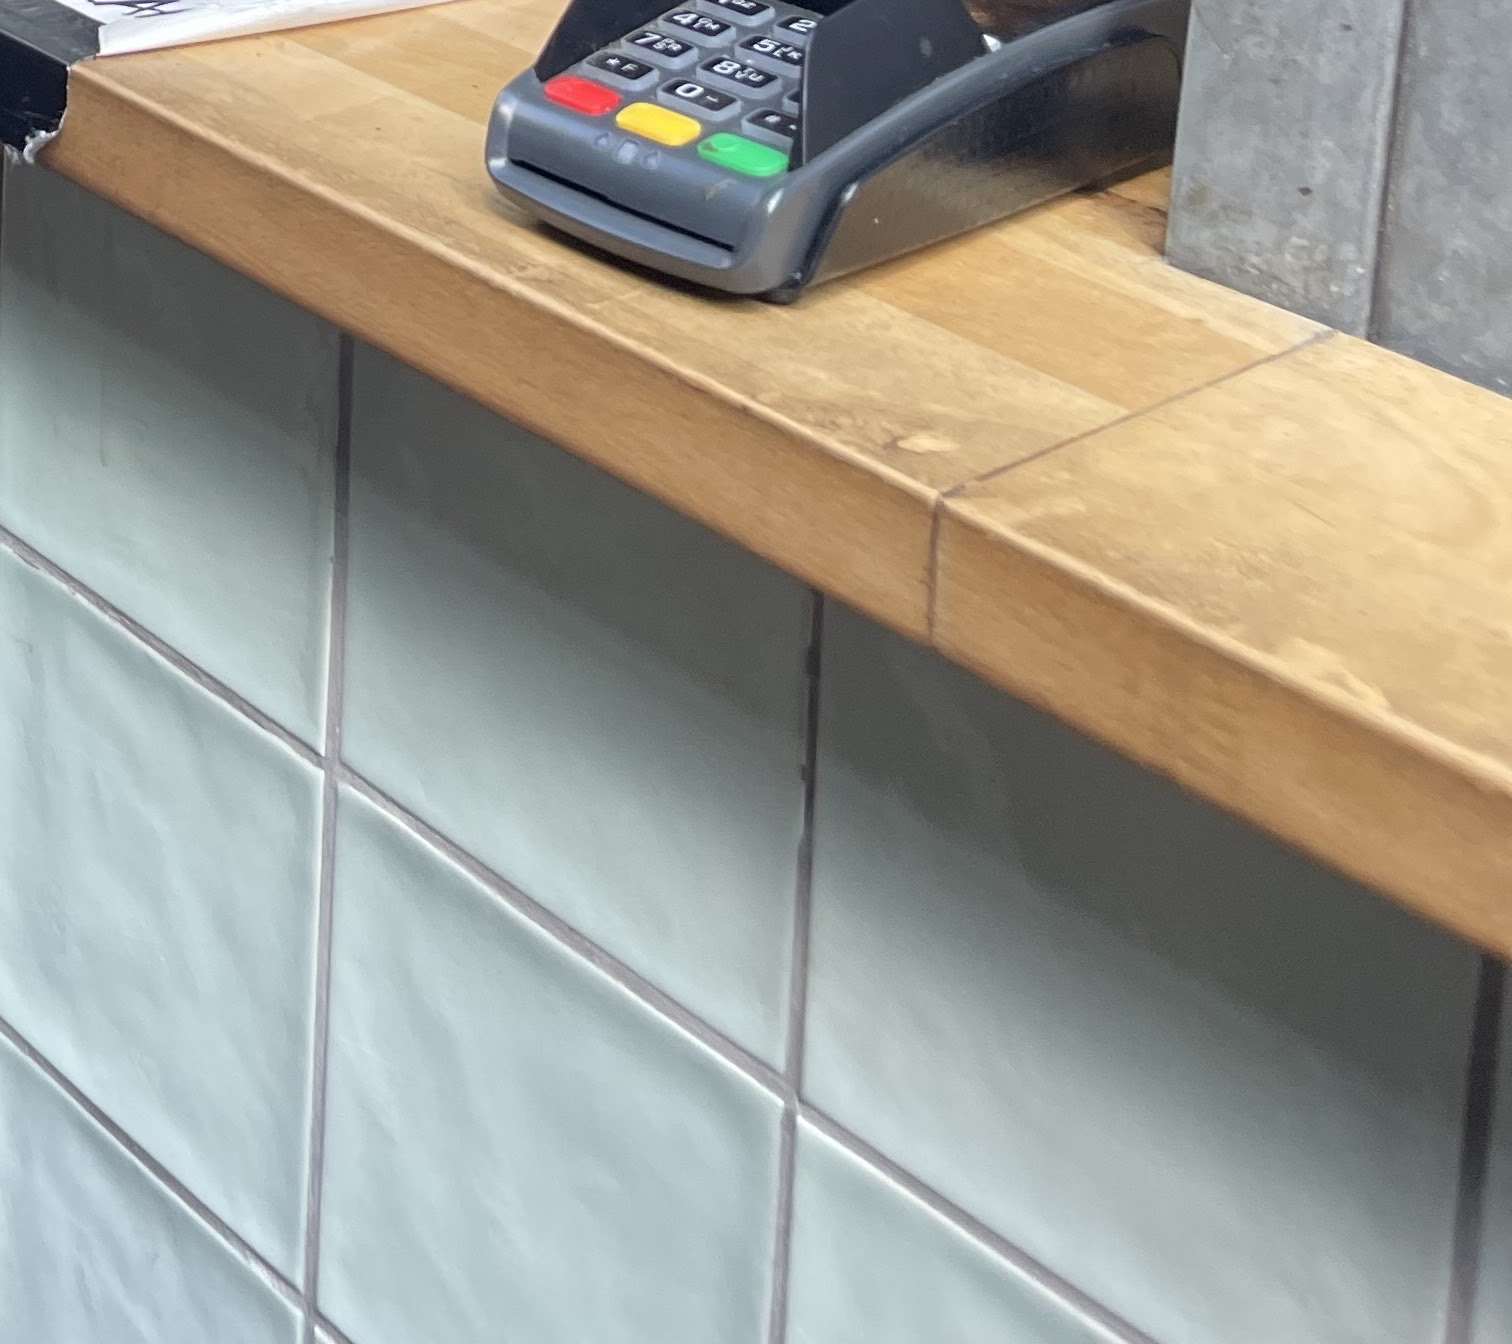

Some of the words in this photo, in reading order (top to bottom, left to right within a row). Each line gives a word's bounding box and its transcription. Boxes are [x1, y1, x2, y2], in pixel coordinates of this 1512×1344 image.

[672, 13, 699, 26] 4
[789, 19, 817, 32] 2
[634, 32, 662, 45] 7
[752, 39, 781, 53] 5
[712, 60, 741, 74] 8
[675, 83, 704, 98] 0
